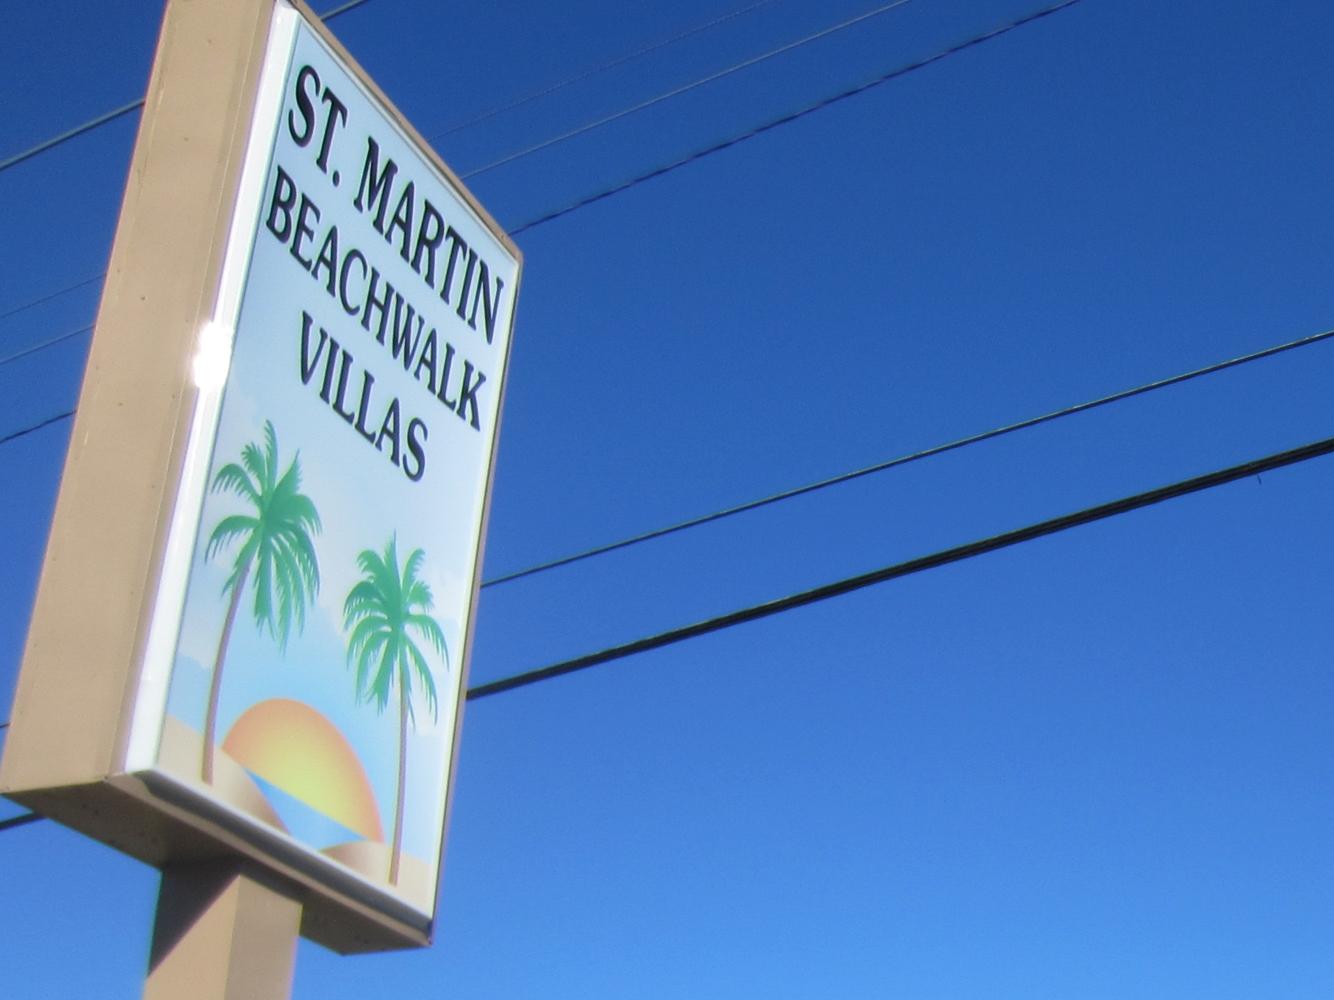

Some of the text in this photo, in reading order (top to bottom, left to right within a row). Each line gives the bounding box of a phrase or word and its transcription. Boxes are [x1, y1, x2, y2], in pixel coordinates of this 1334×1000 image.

[265, 165, 487, 432] BEACHWALK
[288, 64, 504, 345] ST. MARTIN
[299, 310, 429, 482] VILLAS
